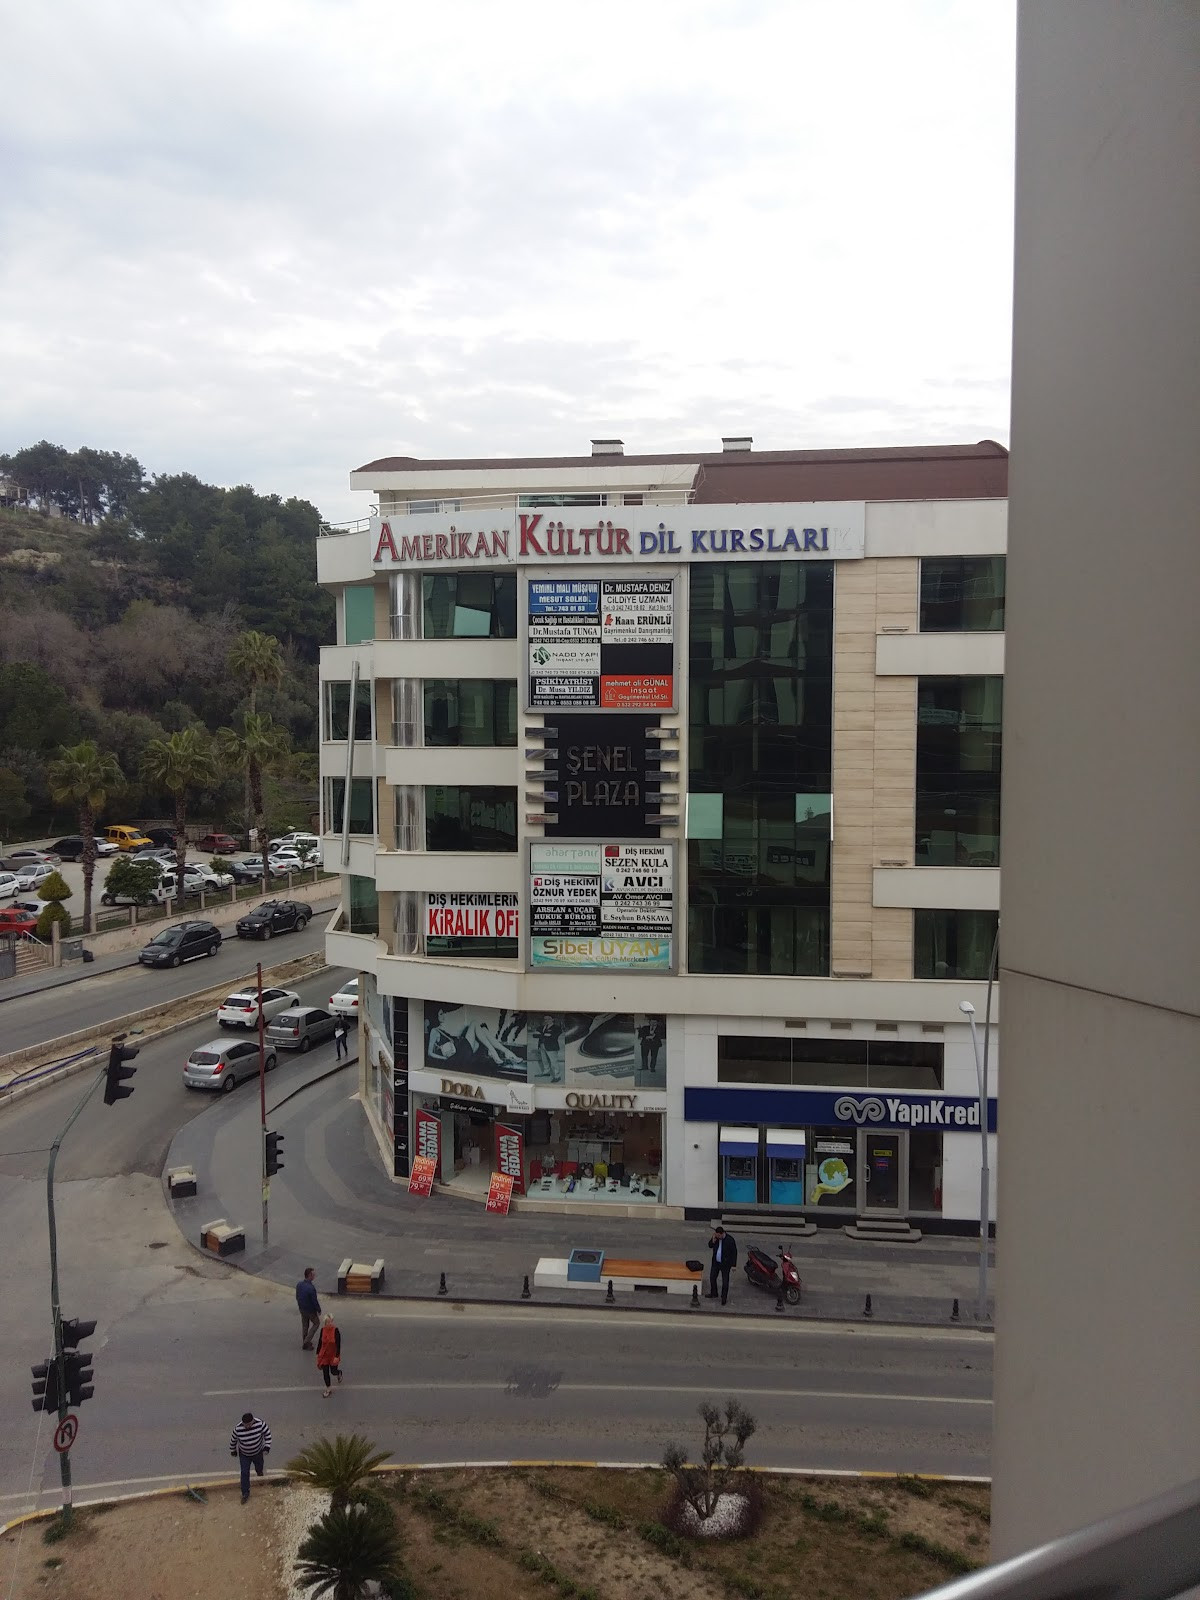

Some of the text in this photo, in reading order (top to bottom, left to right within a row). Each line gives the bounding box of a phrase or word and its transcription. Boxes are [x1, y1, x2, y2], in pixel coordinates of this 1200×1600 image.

[373, 522, 510, 562] AMERİKAN
[518, 514, 632, 556] KÜLTÜR
[640, 522, 682, 555] DİL
[691, 527, 829, 554] KURSLARI
[605, 583, 614, 592] Dr.
[615, 583, 648, 592] MUSTAFA
[615, 613, 672, 625] Kaan ERÜNLÜ
[533, 627, 598, 636] Dr.Mustafa TUNGA
[603, 627, 672, 635] Gayrimenkul Danışmanlığı
[536, 677, 593, 685] PSİKİYATRİST
[606, 679, 631, 687] mehmet
[643, 678, 668, 687] GÜNAL
[566, 744, 638, 776] ŞENEL
[564, 780, 640, 806] PLAZA
[625, 847, 665, 856] DİŞ HEKİMİ
[605, 858, 639, 867] SEZEN
[642, 858, 669, 867] KULA
[544, 877, 599, 887] DİŞ HEKİMİ
[623, 877, 663, 887] AVCI
[533, 887, 598, 897] ÖZNUR YEDEK
[573, 906, 595, 914] UÇAR
[543, 939, 659, 956] Sibel UYAN
[440, 1078, 486, 1100] DORA
[565, 1092, 637, 1110] QUALITY
[886, 1098, 980, 1126] YapıKred
[419, 1121, 427, 1158] ALANA
[427, 1121, 438, 1160] BEDAVA
[500, 1135, 510, 1174] ALANA
[508, 1135, 520, 1177] BEDAVA
